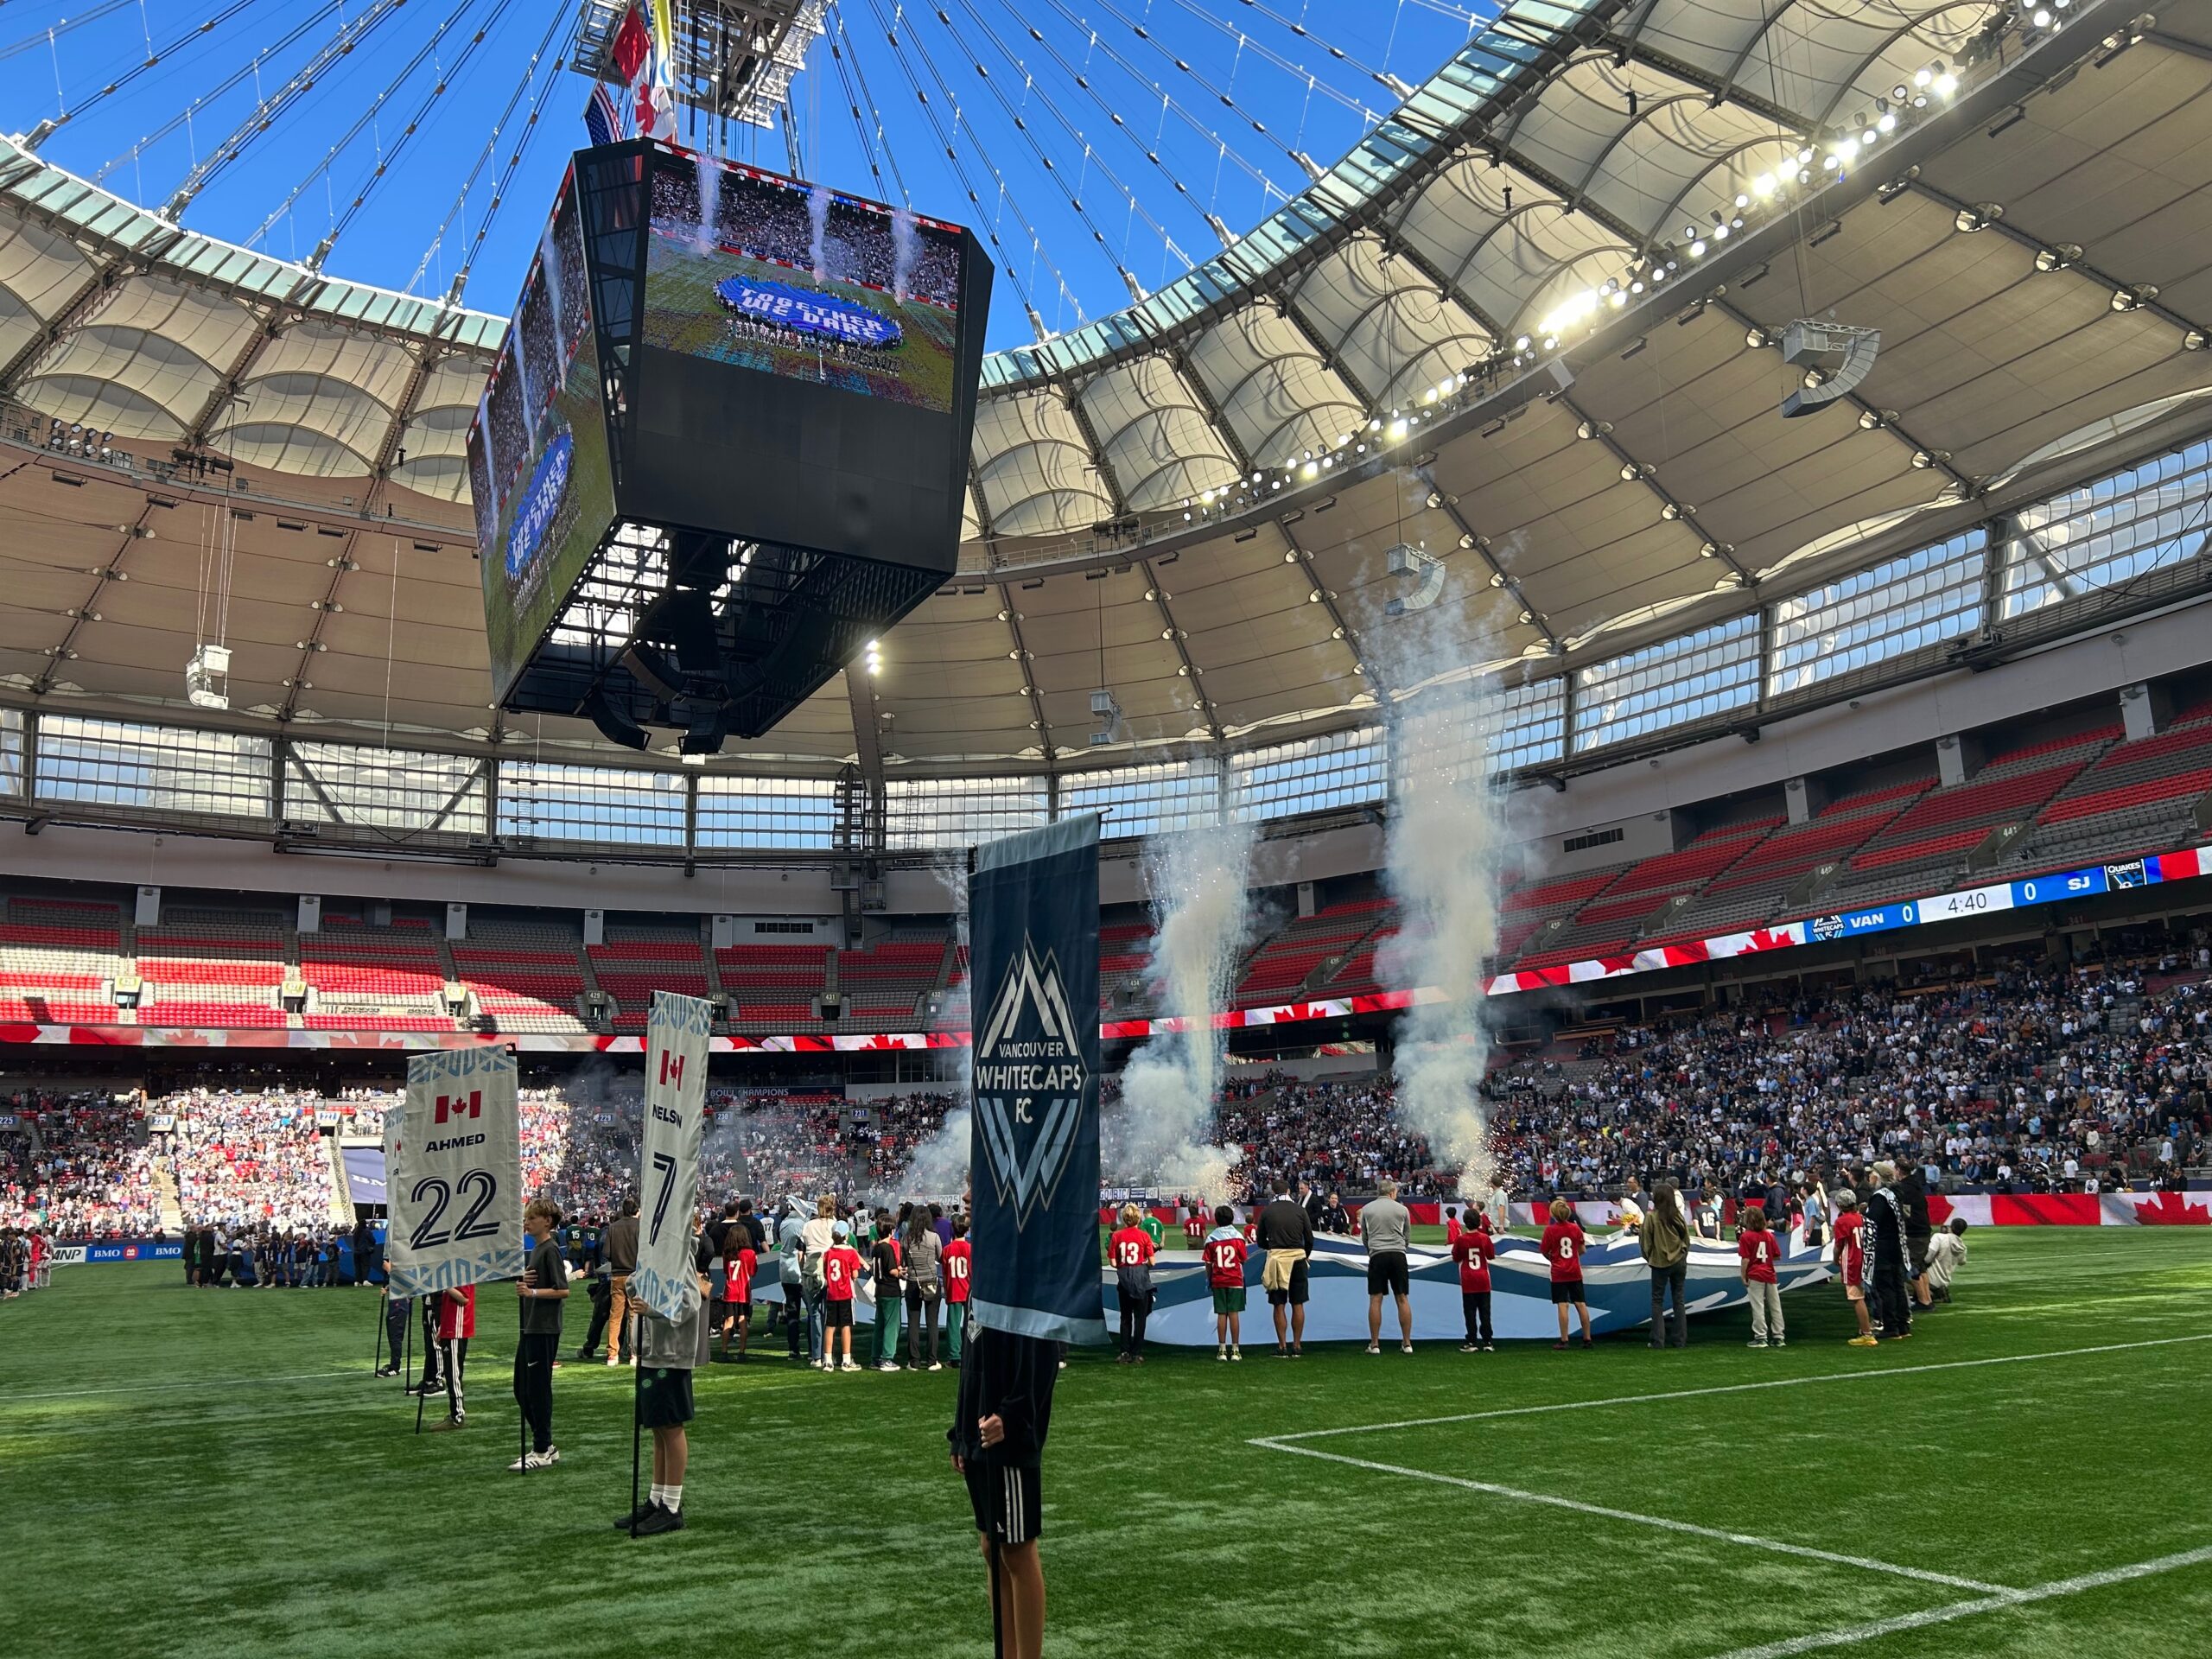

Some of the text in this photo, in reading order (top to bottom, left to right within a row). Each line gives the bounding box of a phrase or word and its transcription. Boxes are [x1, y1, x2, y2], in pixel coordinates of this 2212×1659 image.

[740, 284, 884, 332] TOGETHER
[741, 296, 880, 340] WE DARE
[2107, 861, 2141, 874] QUAKES
[2024, 882, 2037, 901] 0
[2067, 876, 2091, 892] SJ
[1948, 892, 1987, 914] 4:40
[1849, 912, 1885, 929] VAN
[1902, 905, 1913, 923] 0
[999, 1041, 1065, 1058] VANCOUVER
[976, 1064, 1082, 1090] WHITECAPS
[738, 1088, 790, 1097] HAMPIONS
[1015, 1096, 1033, 1124] FC
[425, 1133, 486, 1153] AHMED
[352, 1174, 387, 1187] BM
[410, 1167, 501, 1251] 22
[649, 1151, 677, 1247] 7
[764, 1223, 772, 1232] 17
[1700, 1211, 1715, 1227] 16
[571, 1230, 581, 1240] 15
[1150, 1223, 1157, 1236] 7
[1189, 1223, 1201, 1236] 11
[94, 1249, 120, 1258] BMO
[155, 1247, 181, 1255] BMO
[1119, 1241, 1140, 1265] 13
[1215, 1245, 1236, 1268] 12
[1560, 1236, 1573, 1259] 8
[1756, 1241, 1769, 1263] 4
[948, 1255, 968, 1279] 10
[1468, 1248, 1481, 1270] 5
[729, 1259, 741, 1281] 7
[830, 1258, 841, 1281] 3
